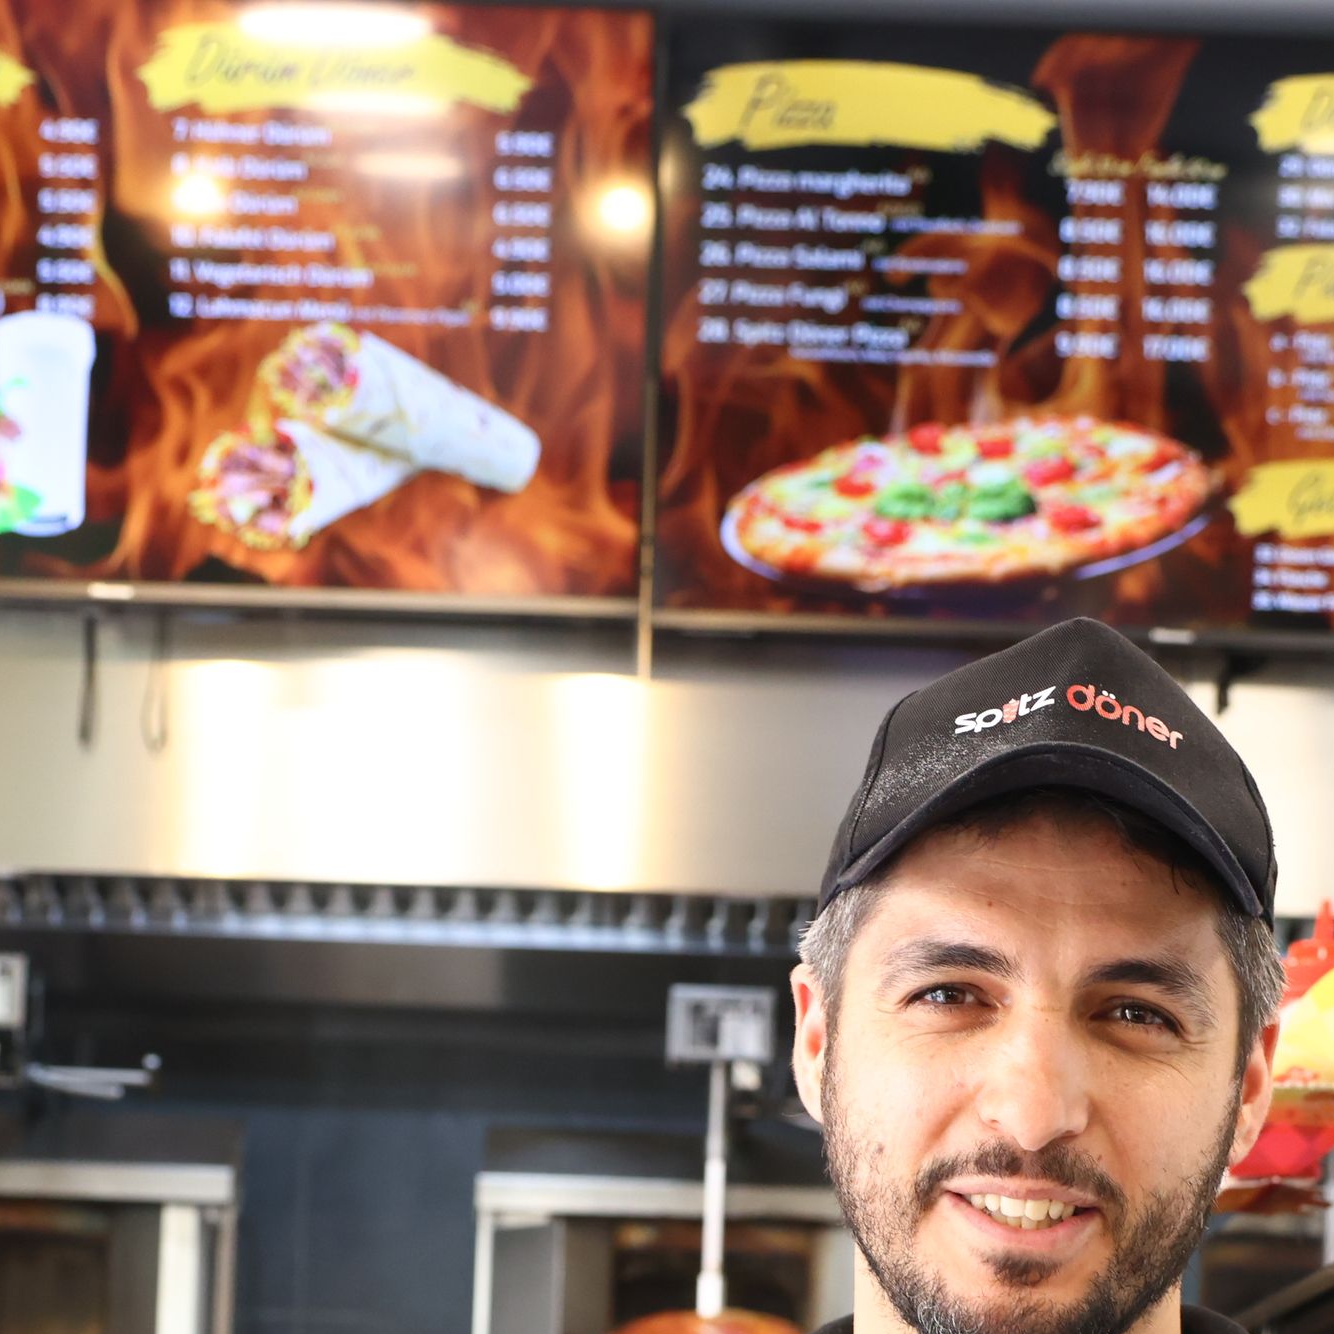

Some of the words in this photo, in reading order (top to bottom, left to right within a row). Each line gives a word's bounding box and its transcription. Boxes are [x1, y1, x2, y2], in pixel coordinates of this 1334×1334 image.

[739, 73, 837, 132] Pizza
[738, 165, 794, 192] Pizza
[796, 170, 911, 199] margherita
[736, 203, 793, 230] Pizza
[734, 242, 790, 269] Pizza
[791, 245, 866, 271] Salami
[730, 280, 786, 307] Pizza
[851, 322, 910, 350] Pizza
[1066, 684, 1184, 749] döner
